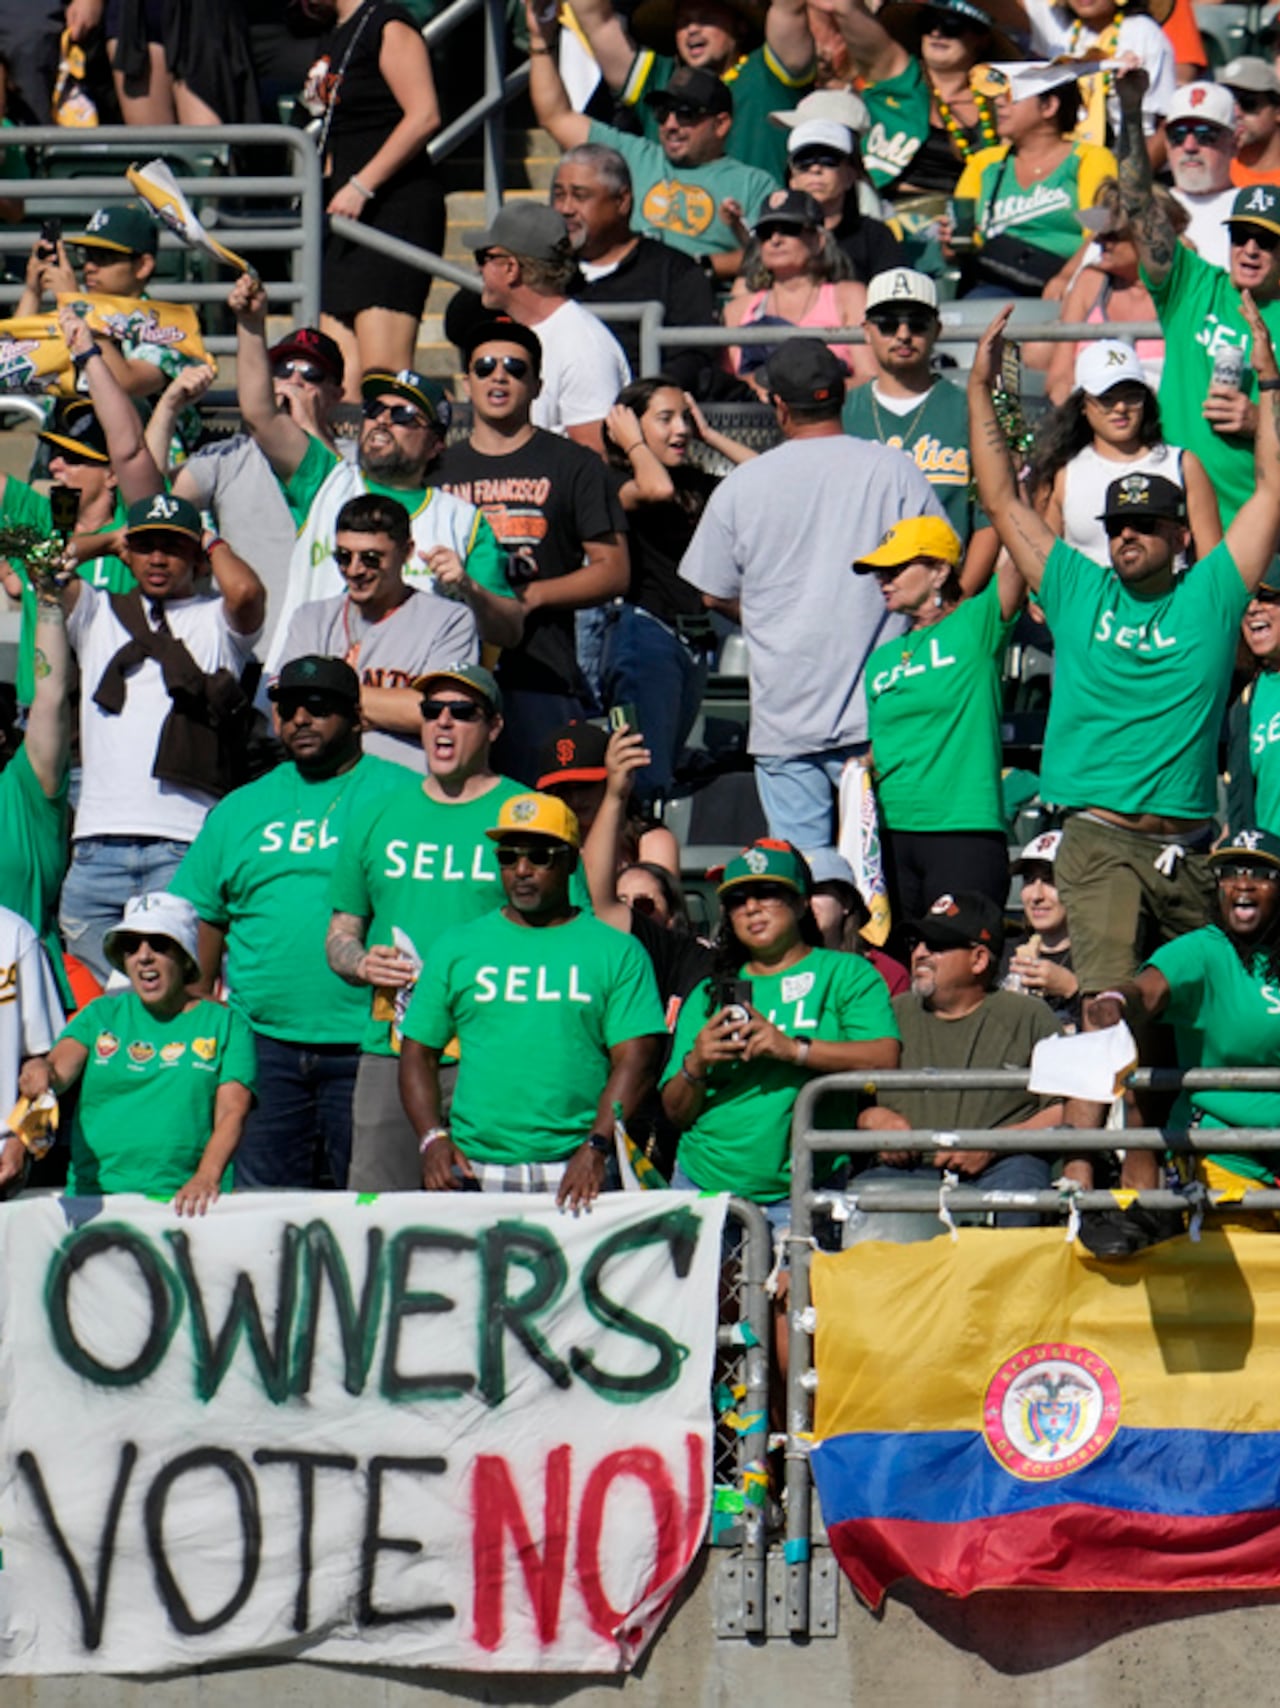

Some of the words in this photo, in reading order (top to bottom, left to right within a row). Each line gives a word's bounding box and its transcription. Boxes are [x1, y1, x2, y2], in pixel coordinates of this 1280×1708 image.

[384, 839, 496, 881] SELL
[473, 964, 593, 1003] SELL
[43, 1203, 704, 1408] OWNERS
[17, 1440, 456, 1652] VOTE
